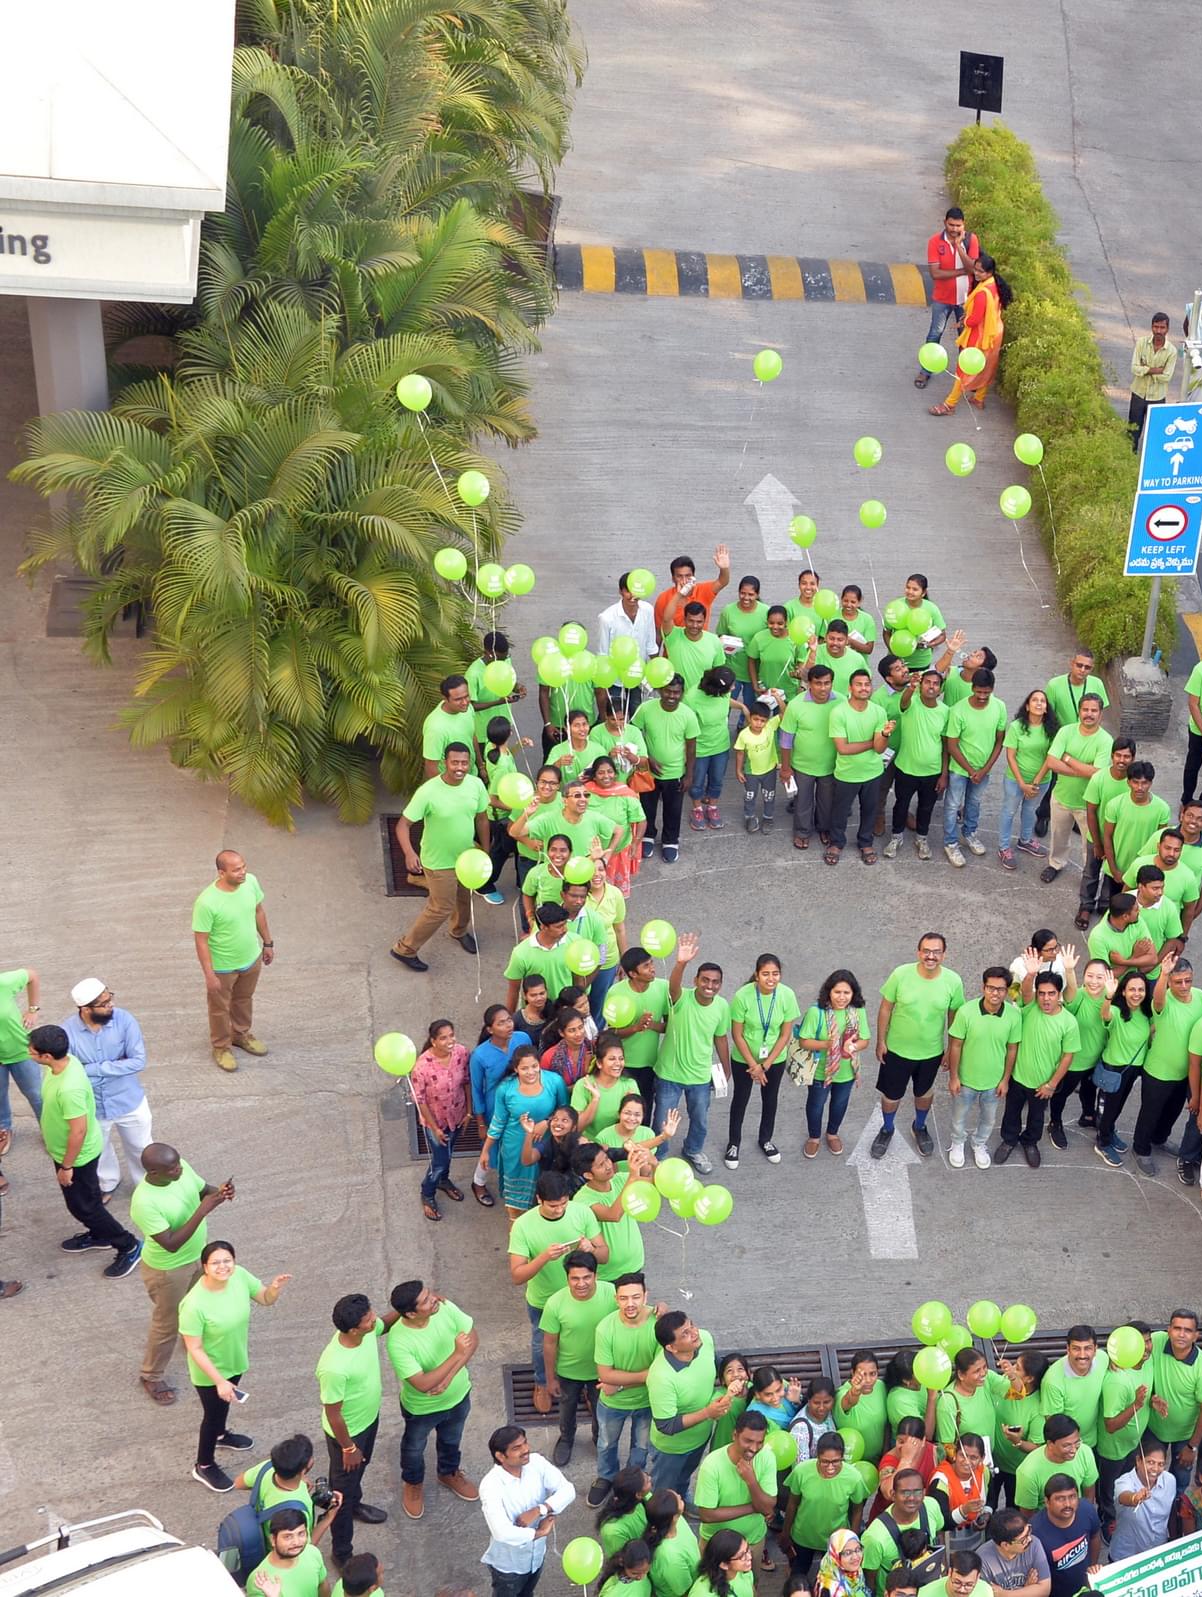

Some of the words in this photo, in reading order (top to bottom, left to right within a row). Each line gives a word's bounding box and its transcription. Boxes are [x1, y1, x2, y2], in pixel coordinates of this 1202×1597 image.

[1143, 478, 1160, 488] WAY
[1161, 477, 1171, 487] TO
[1141, 545, 1164, 554] KEEP
[1166, 545, 1186, 554] LEFT
